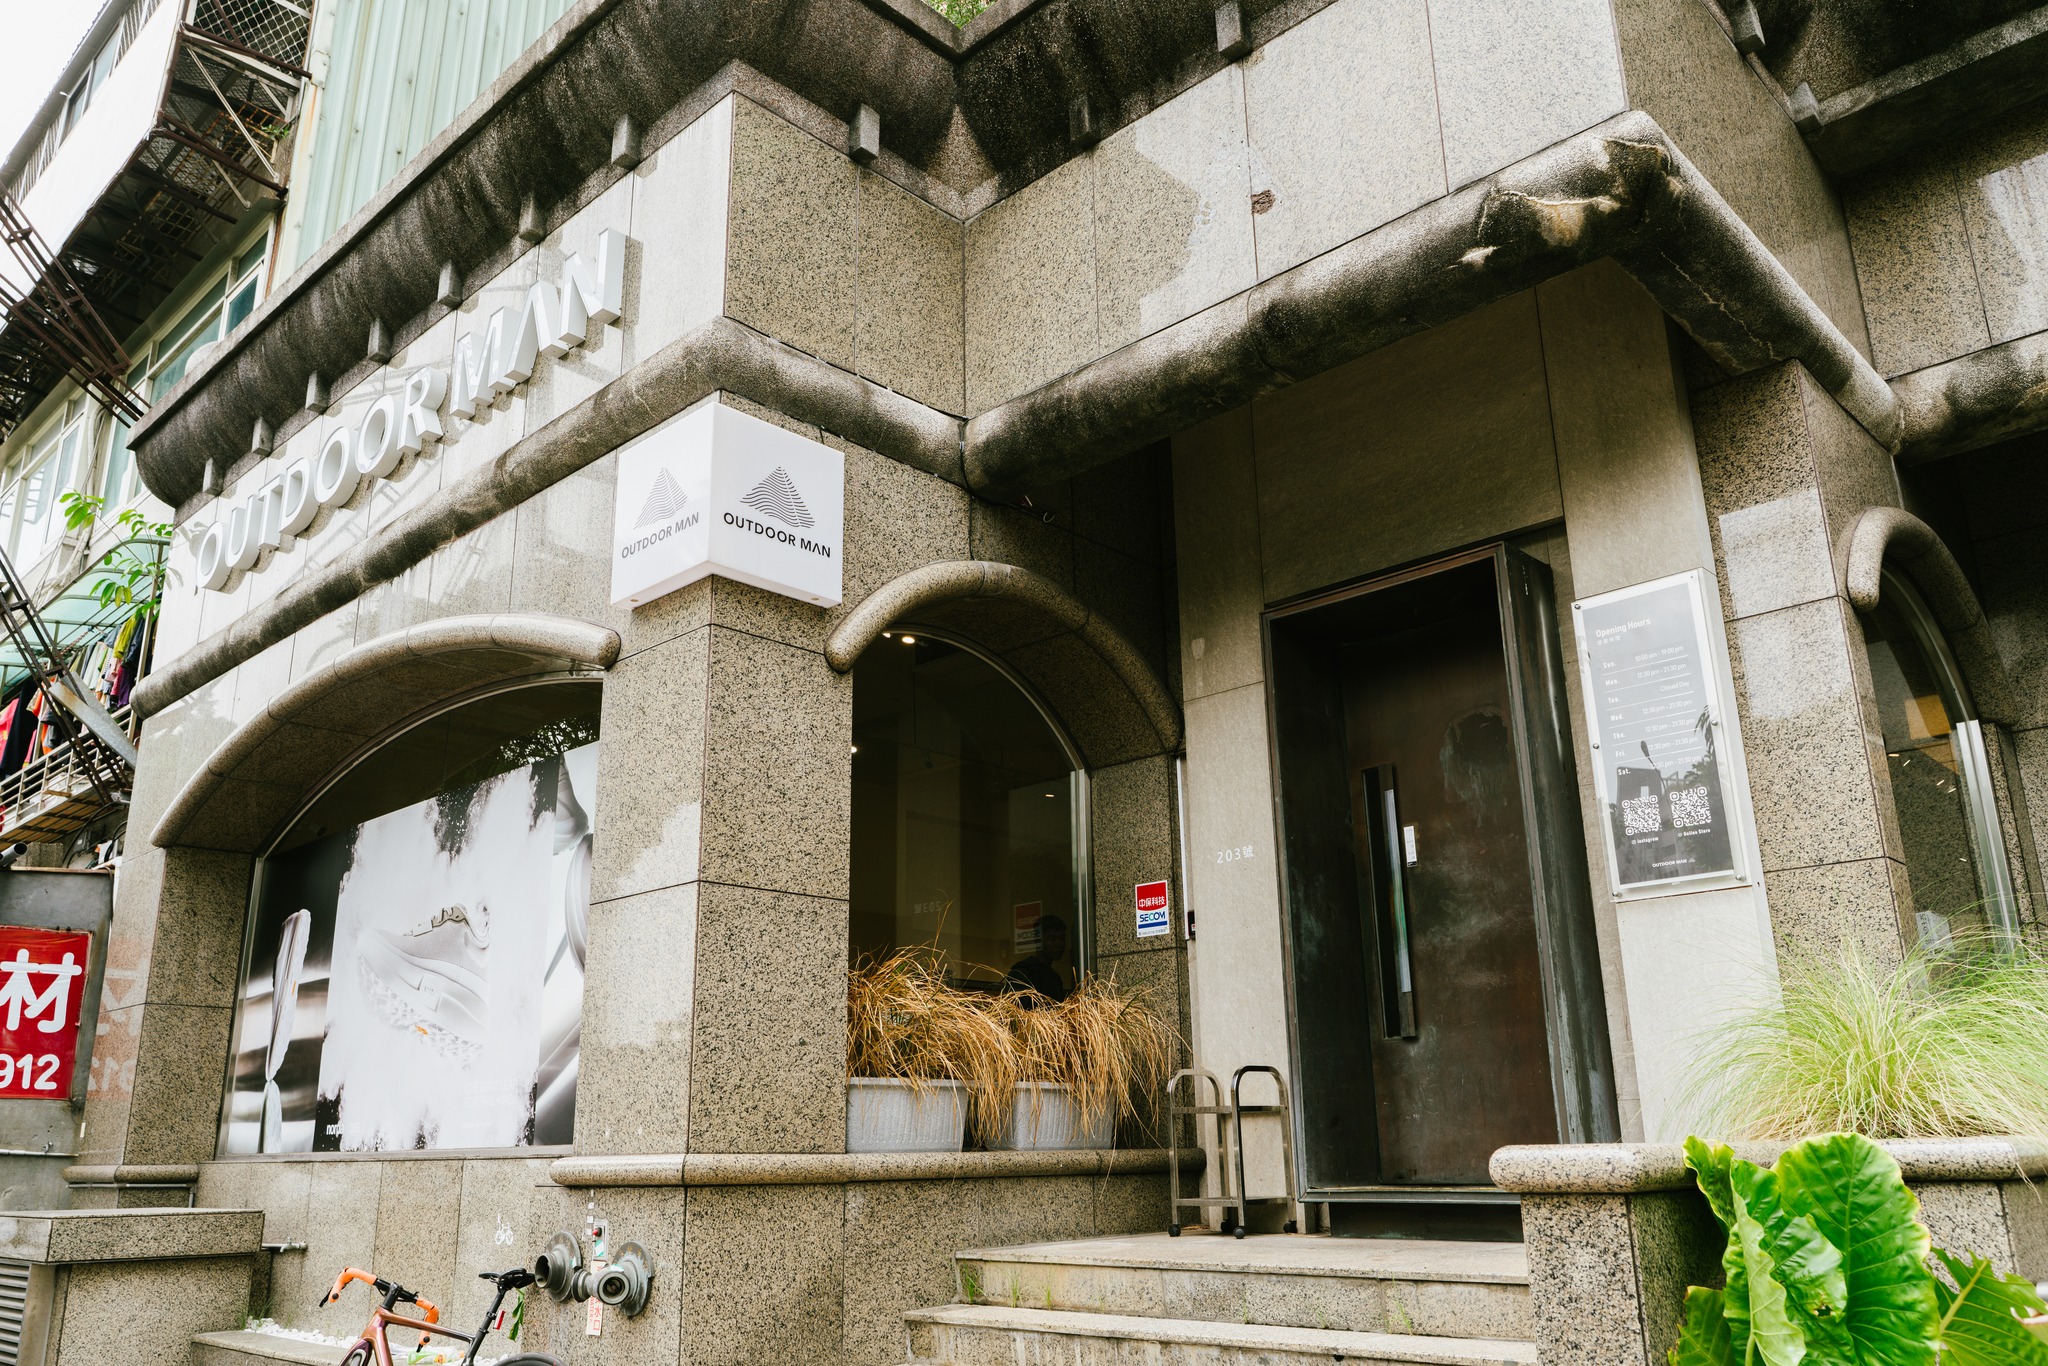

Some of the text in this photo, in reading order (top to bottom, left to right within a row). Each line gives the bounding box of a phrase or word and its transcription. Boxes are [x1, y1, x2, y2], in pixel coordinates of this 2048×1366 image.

[196, 227, 626, 591] OUTDOOR MAN
[621, 511, 699, 559] OUTDOOR MAN
[723, 512, 831, 558] OUTDOOR MAN
[1596, 618, 1651, 638] Opening Hours
[1660, 683, 1679, 692] Closed
[1679, 681, 1690, 689] Day
[1138, 896, 1165, 908] 中保科技
[1140, 911, 1165, 922] SECOM
